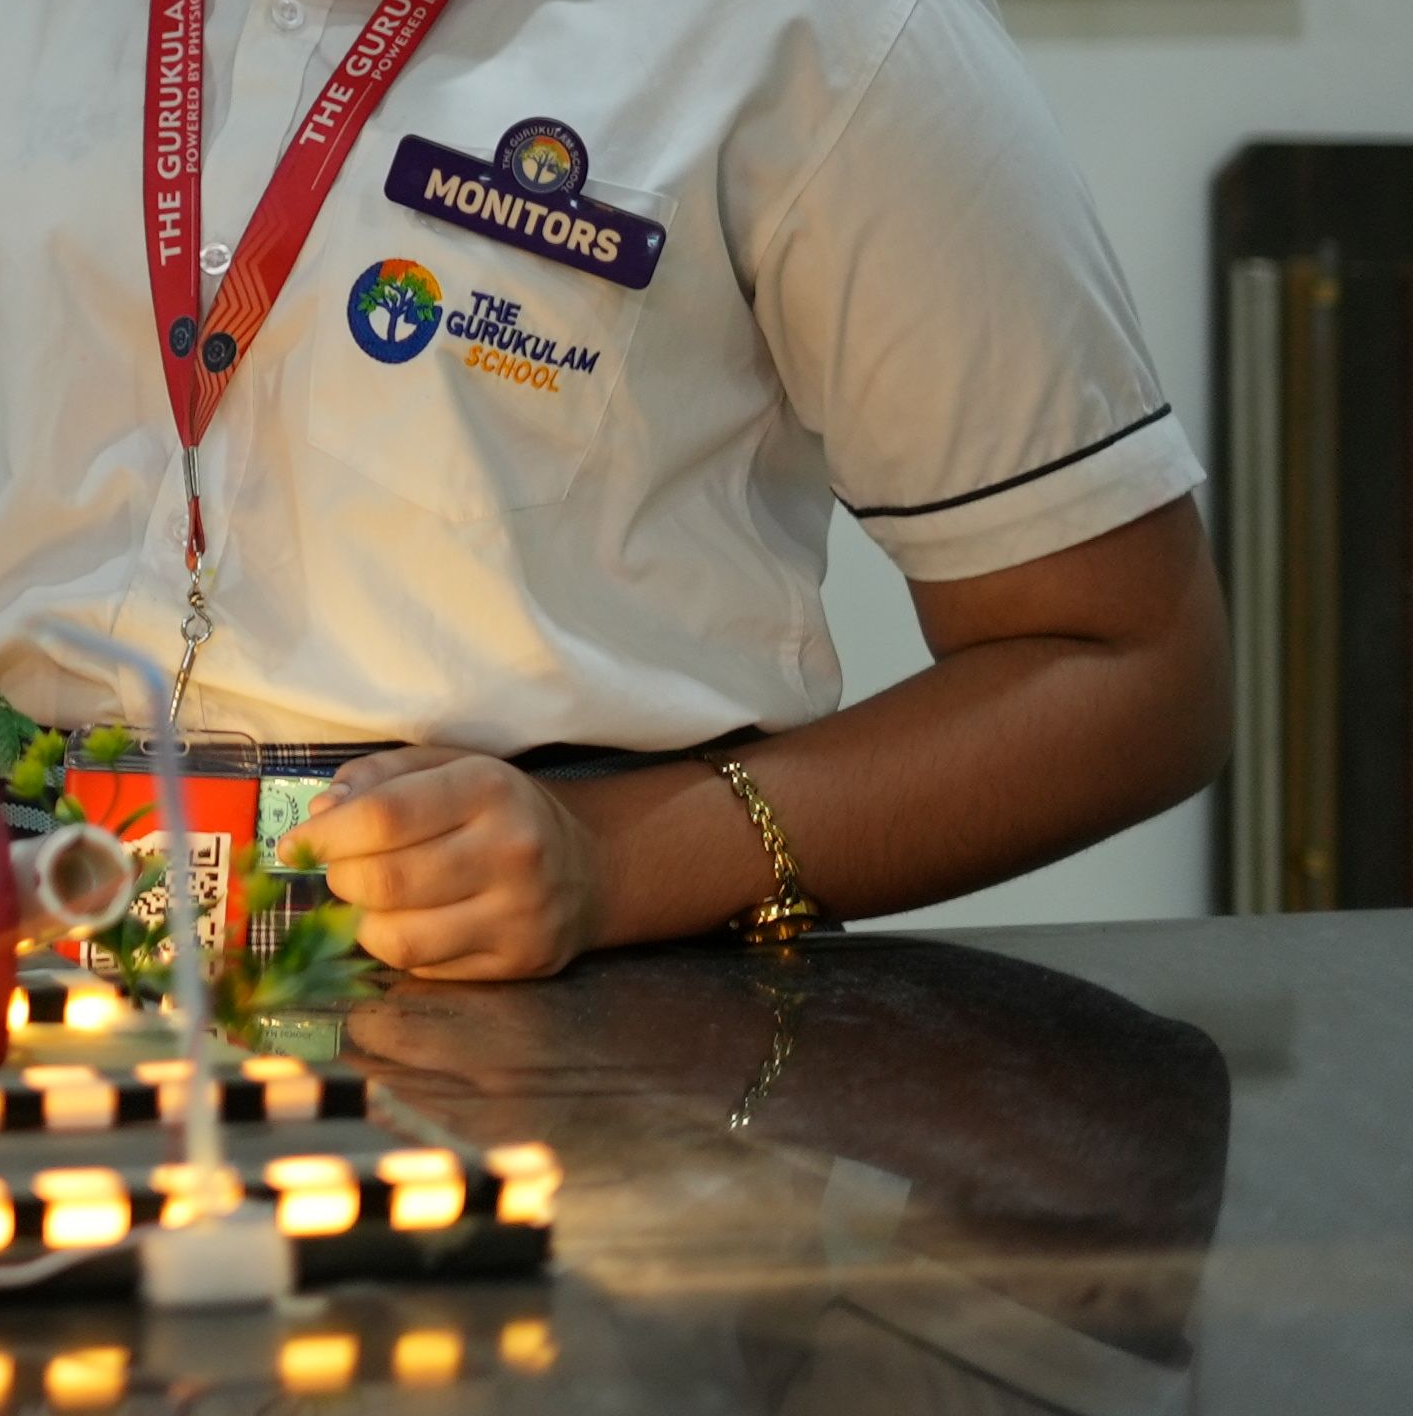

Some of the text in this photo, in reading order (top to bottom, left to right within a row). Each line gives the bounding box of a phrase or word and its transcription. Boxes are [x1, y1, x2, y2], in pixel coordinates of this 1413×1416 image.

[187, 60, 201, 82] BY
[370, 7, 427, 81] POWERED
[186, 86, 200, 173] POWERED
[298, 82, 354, 145] THE
[502, 147, 513, 170] THE
[158, 190, 182, 266] THE
[423, 168, 622, 263] MONITORS
[471, 291, 521, 326] THE
[446, 311, 600, 374] GURUKULAM
[463, 345, 560, 393] SCHOOL
